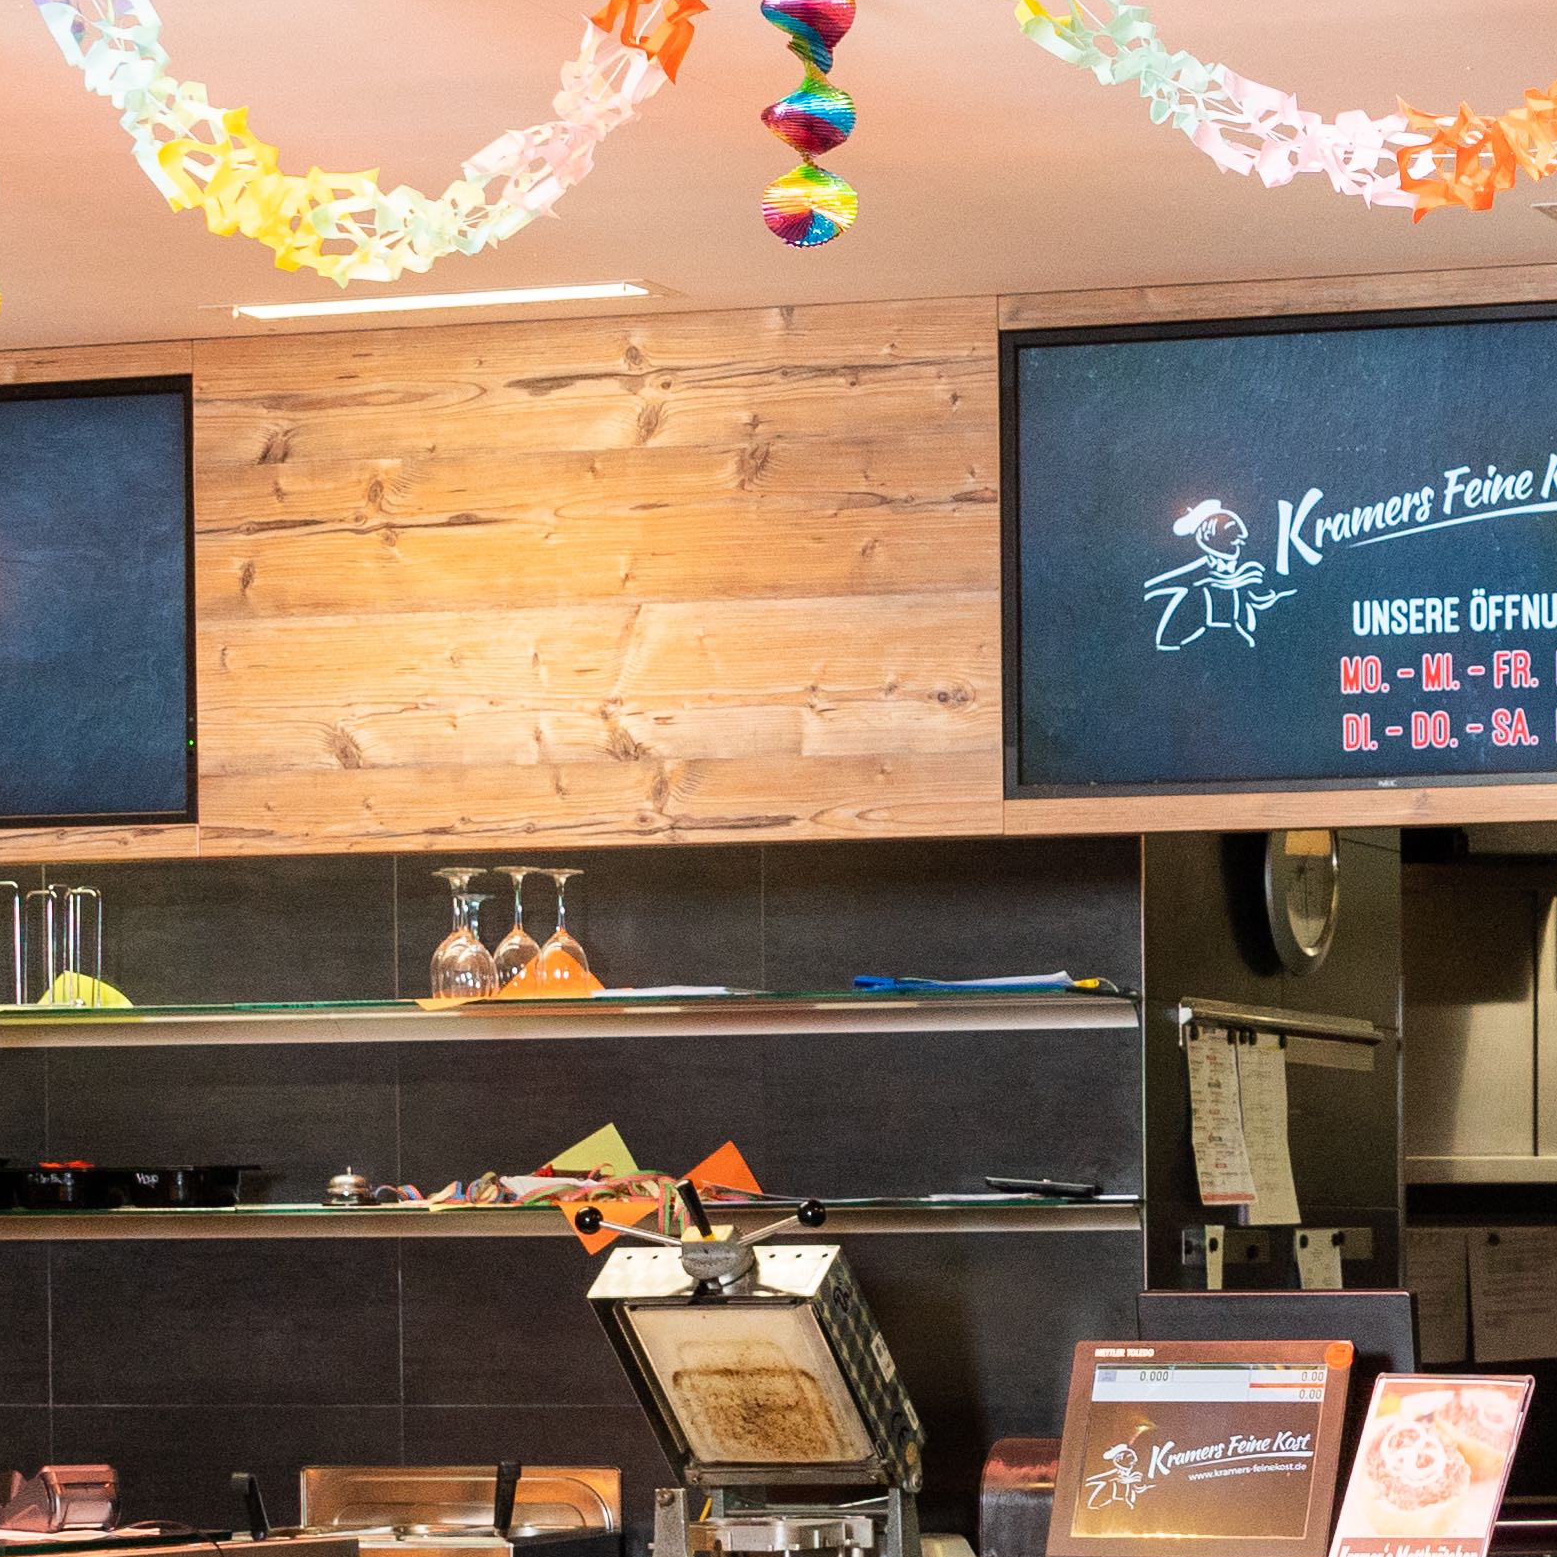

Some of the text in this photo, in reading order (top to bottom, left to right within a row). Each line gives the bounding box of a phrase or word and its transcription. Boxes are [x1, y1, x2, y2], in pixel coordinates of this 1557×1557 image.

[1276, 488, 1434, 575] Kramers
[1443, 465, 1533, 514] Feine
[1353, 597, 1459, 636] UNSERE
[1341, 656, 1390, 694] MO.
[1422, 653, 1460, 691] MI.
[1493, 650, 1539, 689] FR.
[1343, 713, 1378, 751] DI.
[1411, 711, 1458, 749] DO.
[1492, 708, 1538, 746] SA.
[1140, 1370, 1324, 1382] 0.000 0.00
[1299, 1389, 1322, 1400] 0.00
[1147, 1431, 1310, 1479] Kramers Feine Kost
[1187, 1462, 1307, 1481] www.kramers-feinekost.de
